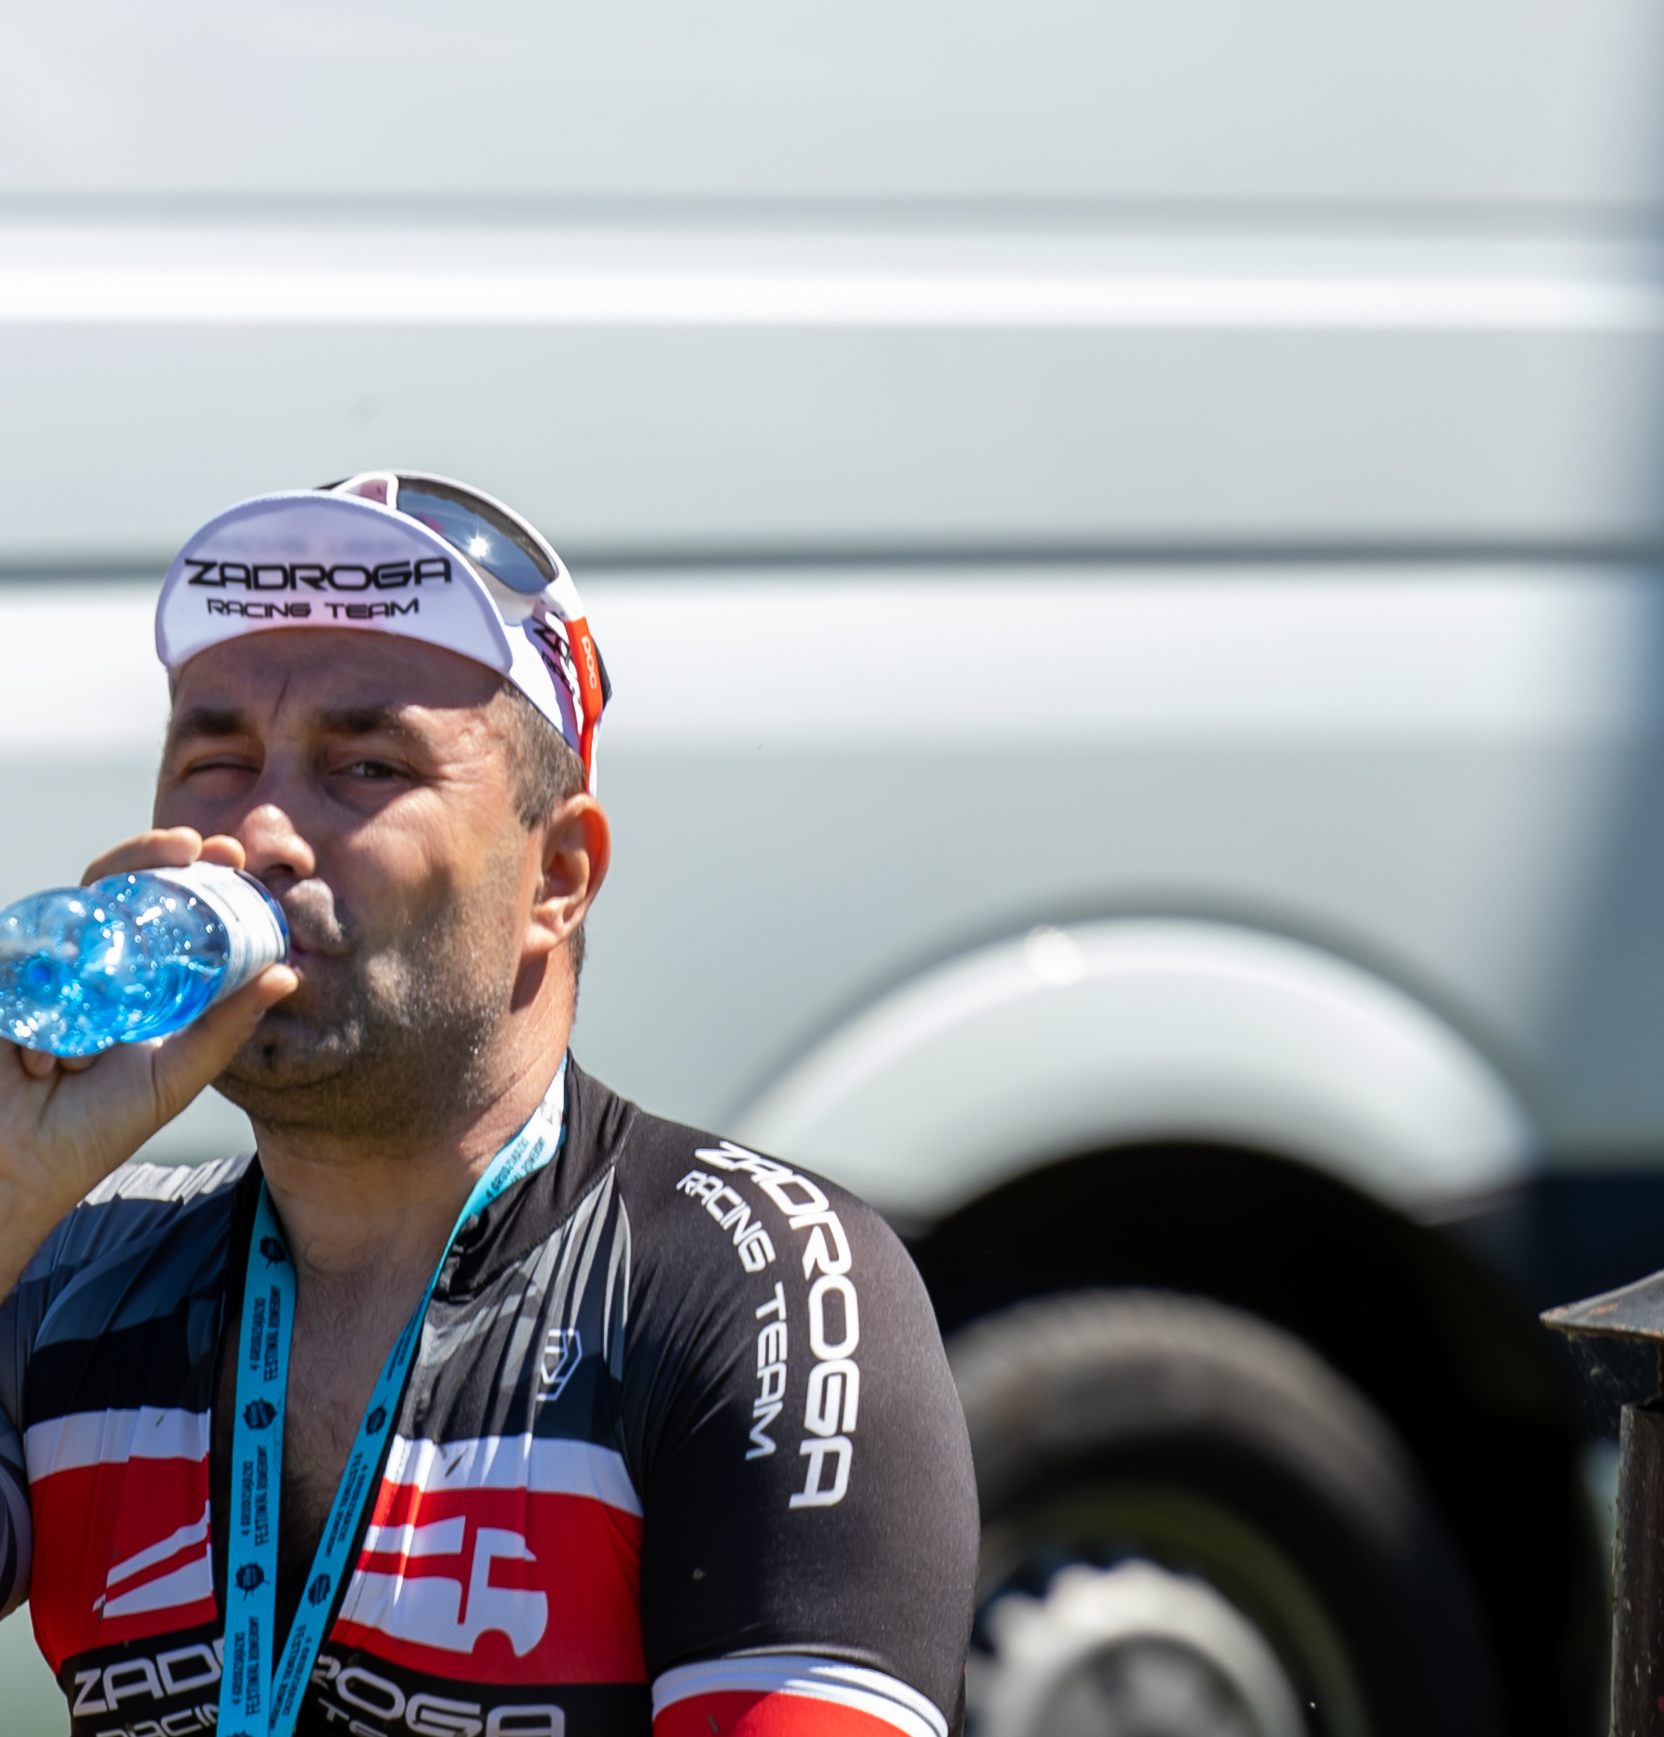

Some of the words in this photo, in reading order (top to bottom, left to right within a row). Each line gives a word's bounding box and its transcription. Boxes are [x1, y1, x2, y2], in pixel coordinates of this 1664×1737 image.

[184, 556, 452, 592] ZADROGA
[206, 596, 312, 620] RACING
[324, 596, 420, 621] TEAM
[675, 1169, 776, 1274] RACING
[745, 1280, 788, 1462] TEAM
[694, 1139, 861, 1510] ZADROGA
